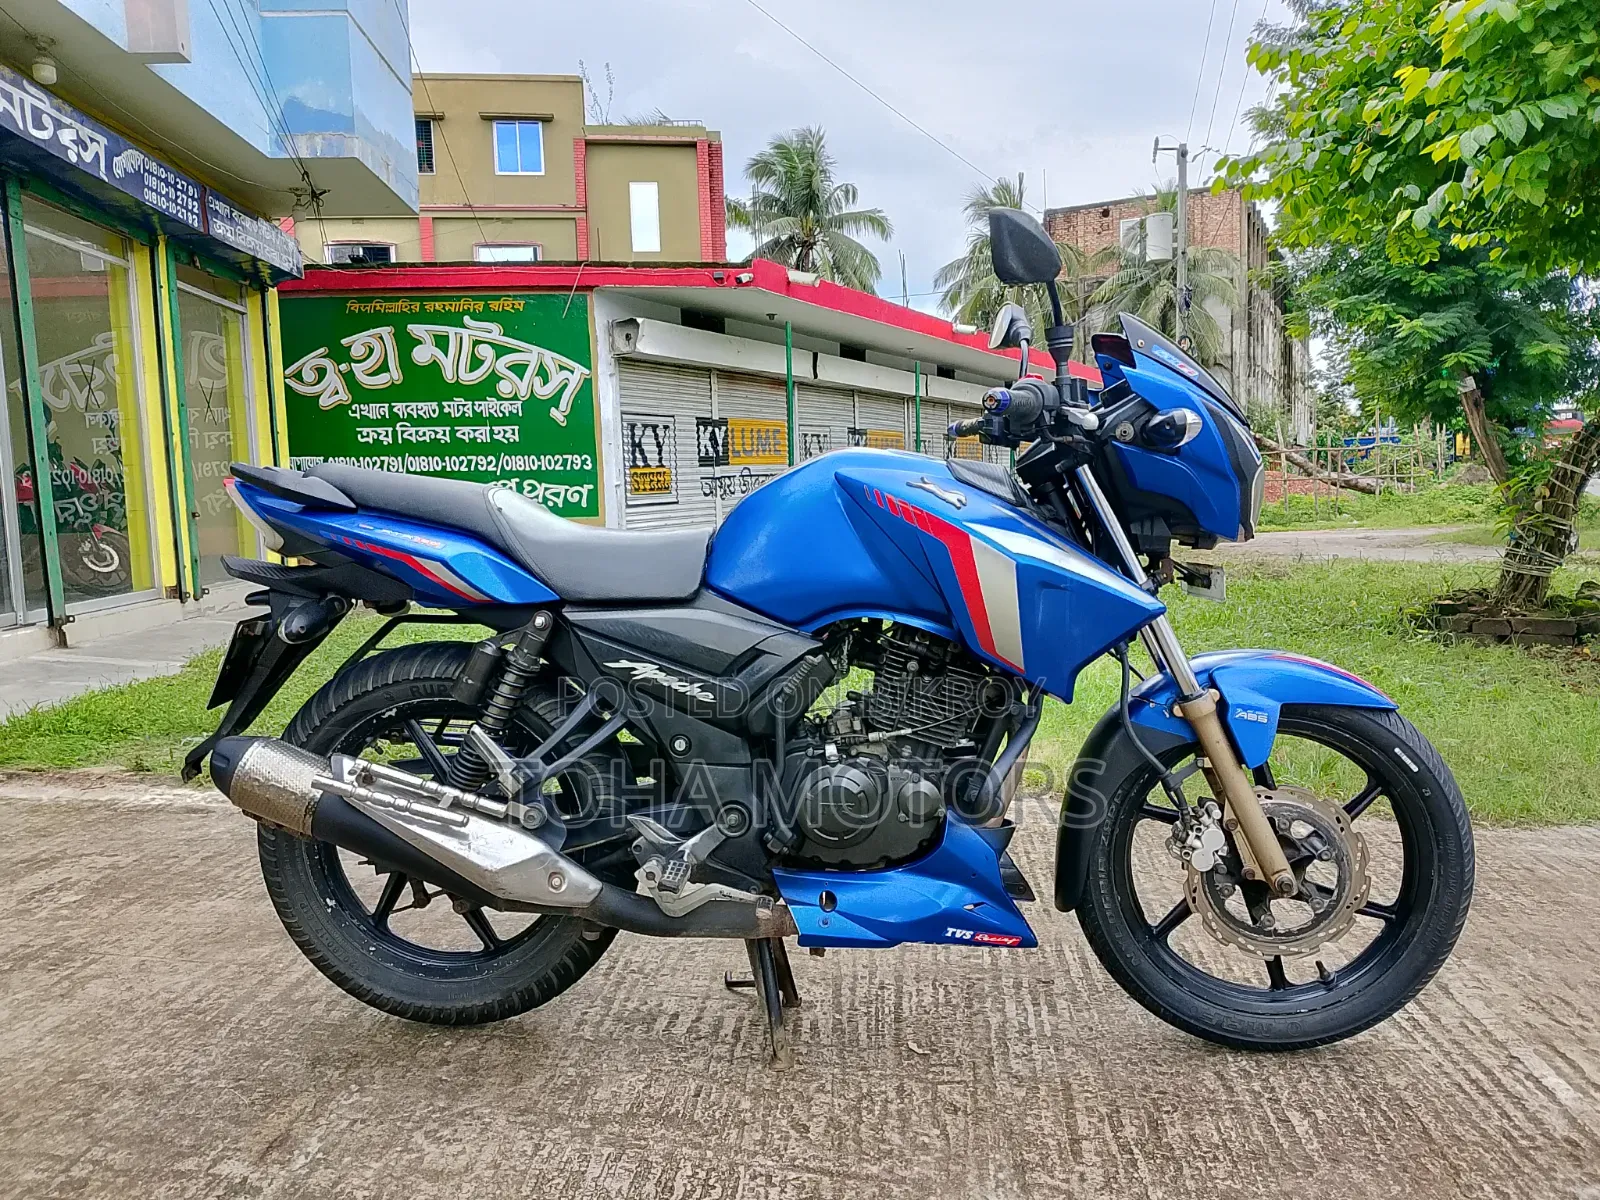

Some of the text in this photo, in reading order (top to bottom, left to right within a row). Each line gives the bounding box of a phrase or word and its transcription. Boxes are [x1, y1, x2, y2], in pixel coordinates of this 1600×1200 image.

[348, 402, 389, 420] এখানে
[356, 426, 393, 446] ক্রয়
[395, 421, 451, 444] বিক্রয়
[626, 423, 670, 468] KY
[632, 471, 671, 492] STEEL
[603, 660, 717, 702] Apache
[945, 927, 1020, 945] TVS Racing
